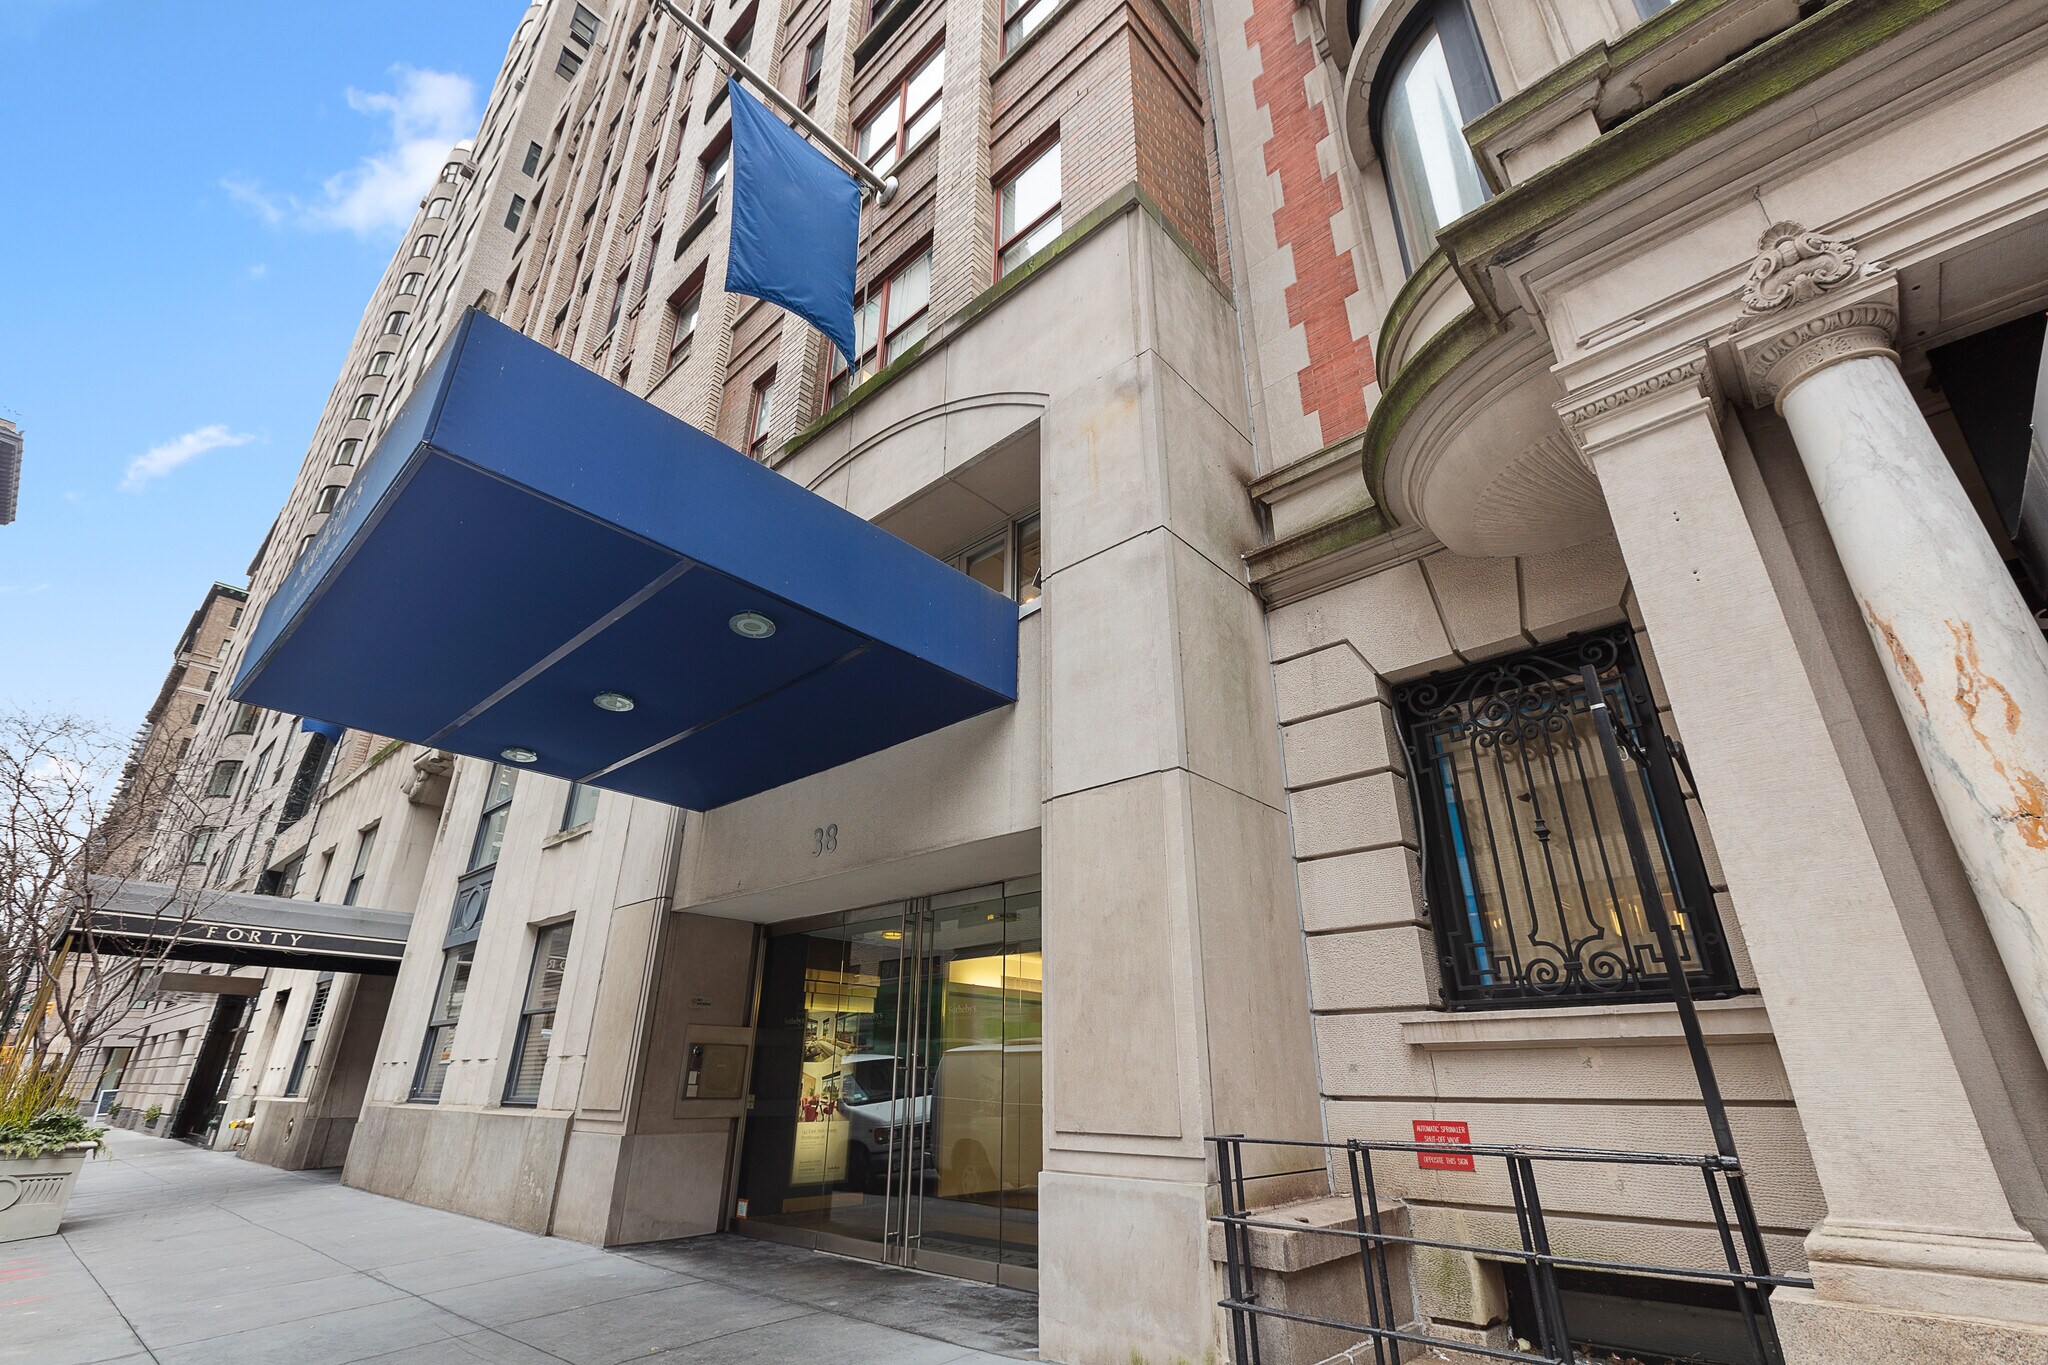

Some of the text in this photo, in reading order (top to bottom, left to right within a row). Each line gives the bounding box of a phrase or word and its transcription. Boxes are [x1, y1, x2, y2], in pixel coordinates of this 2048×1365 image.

[811, 823, 839, 859] 38
[206, 926, 303, 946] FORTY
[1417, 1125, 1466, 1134] AUTOMATIC SPRINKLER
[1424, 1156, 1469, 1166] OPPOSITE THIS SIGN
